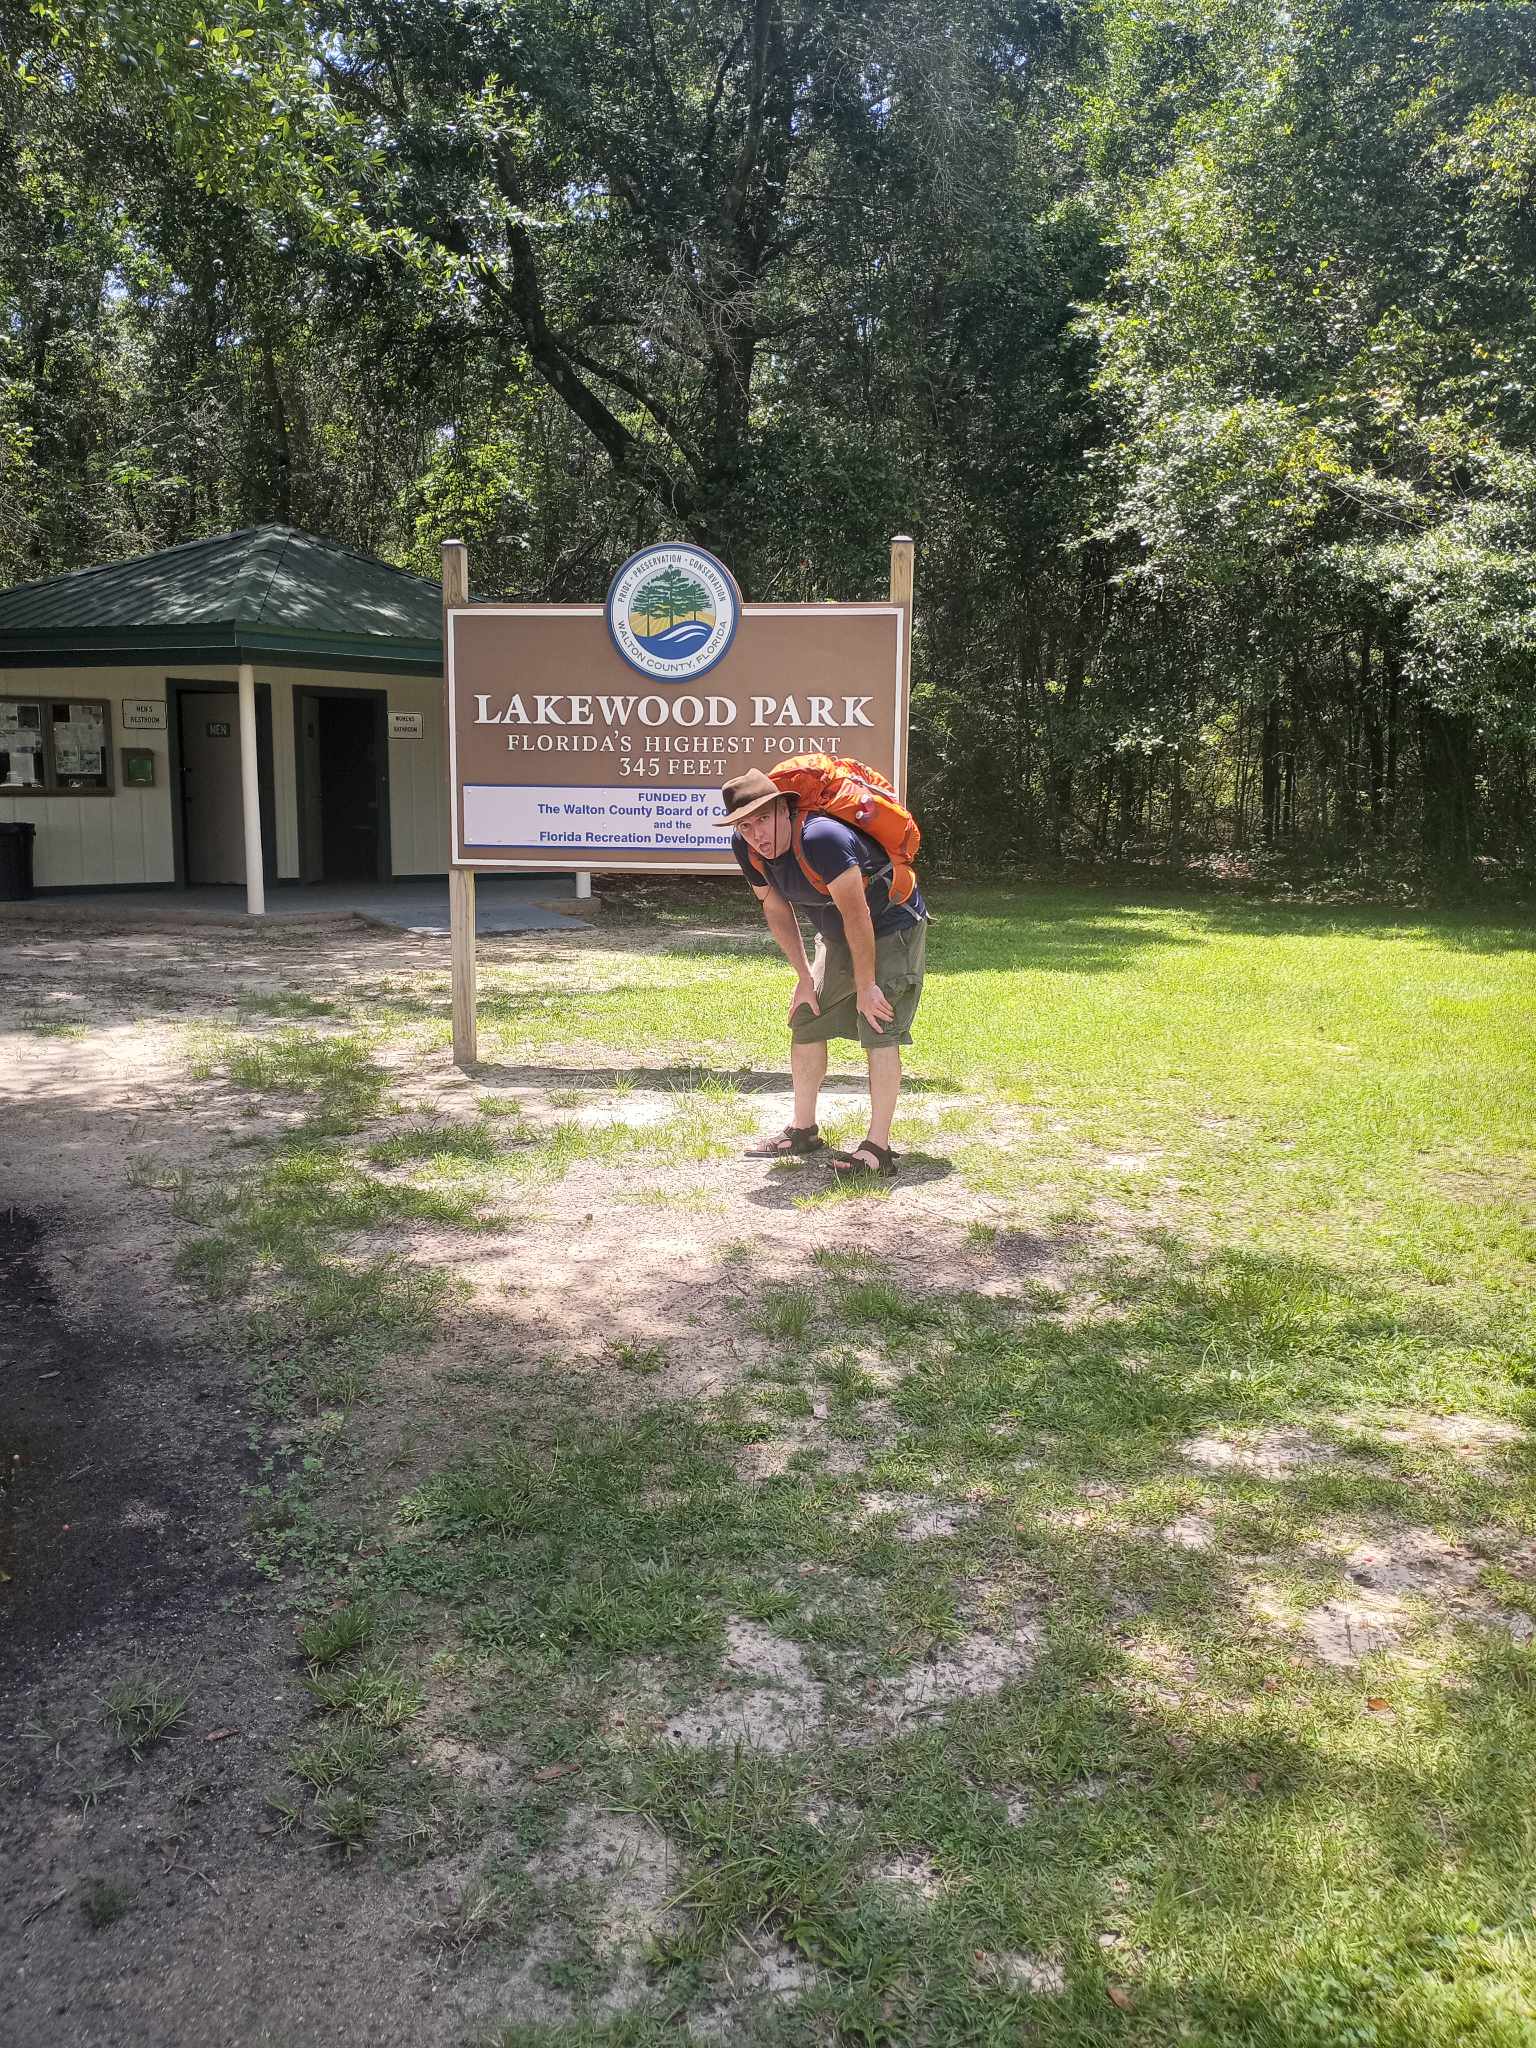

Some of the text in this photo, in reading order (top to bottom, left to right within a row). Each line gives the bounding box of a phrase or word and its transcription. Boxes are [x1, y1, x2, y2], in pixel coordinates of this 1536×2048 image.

[618, 554, 728, 604] PRIDE PRESERVATION CONSERVATION
[617, 620, 728, 672] WALTON COUNTY, FLORIDA
[473, 693, 875, 727] LAKEWOOD PARK
[209, 723, 227, 736] MEN
[506, 730, 841, 754] FLORIDA'S HIGHEST POINT
[618, 757, 727, 777] 345 FEET
[638, 792, 706, 803] FUNDED BY
[537, 803, 730, 818] The Walton County Board of Co
[653, 820, 692, 829] and the
[540, 832, 731, 846] Florida Recreation Developmen
